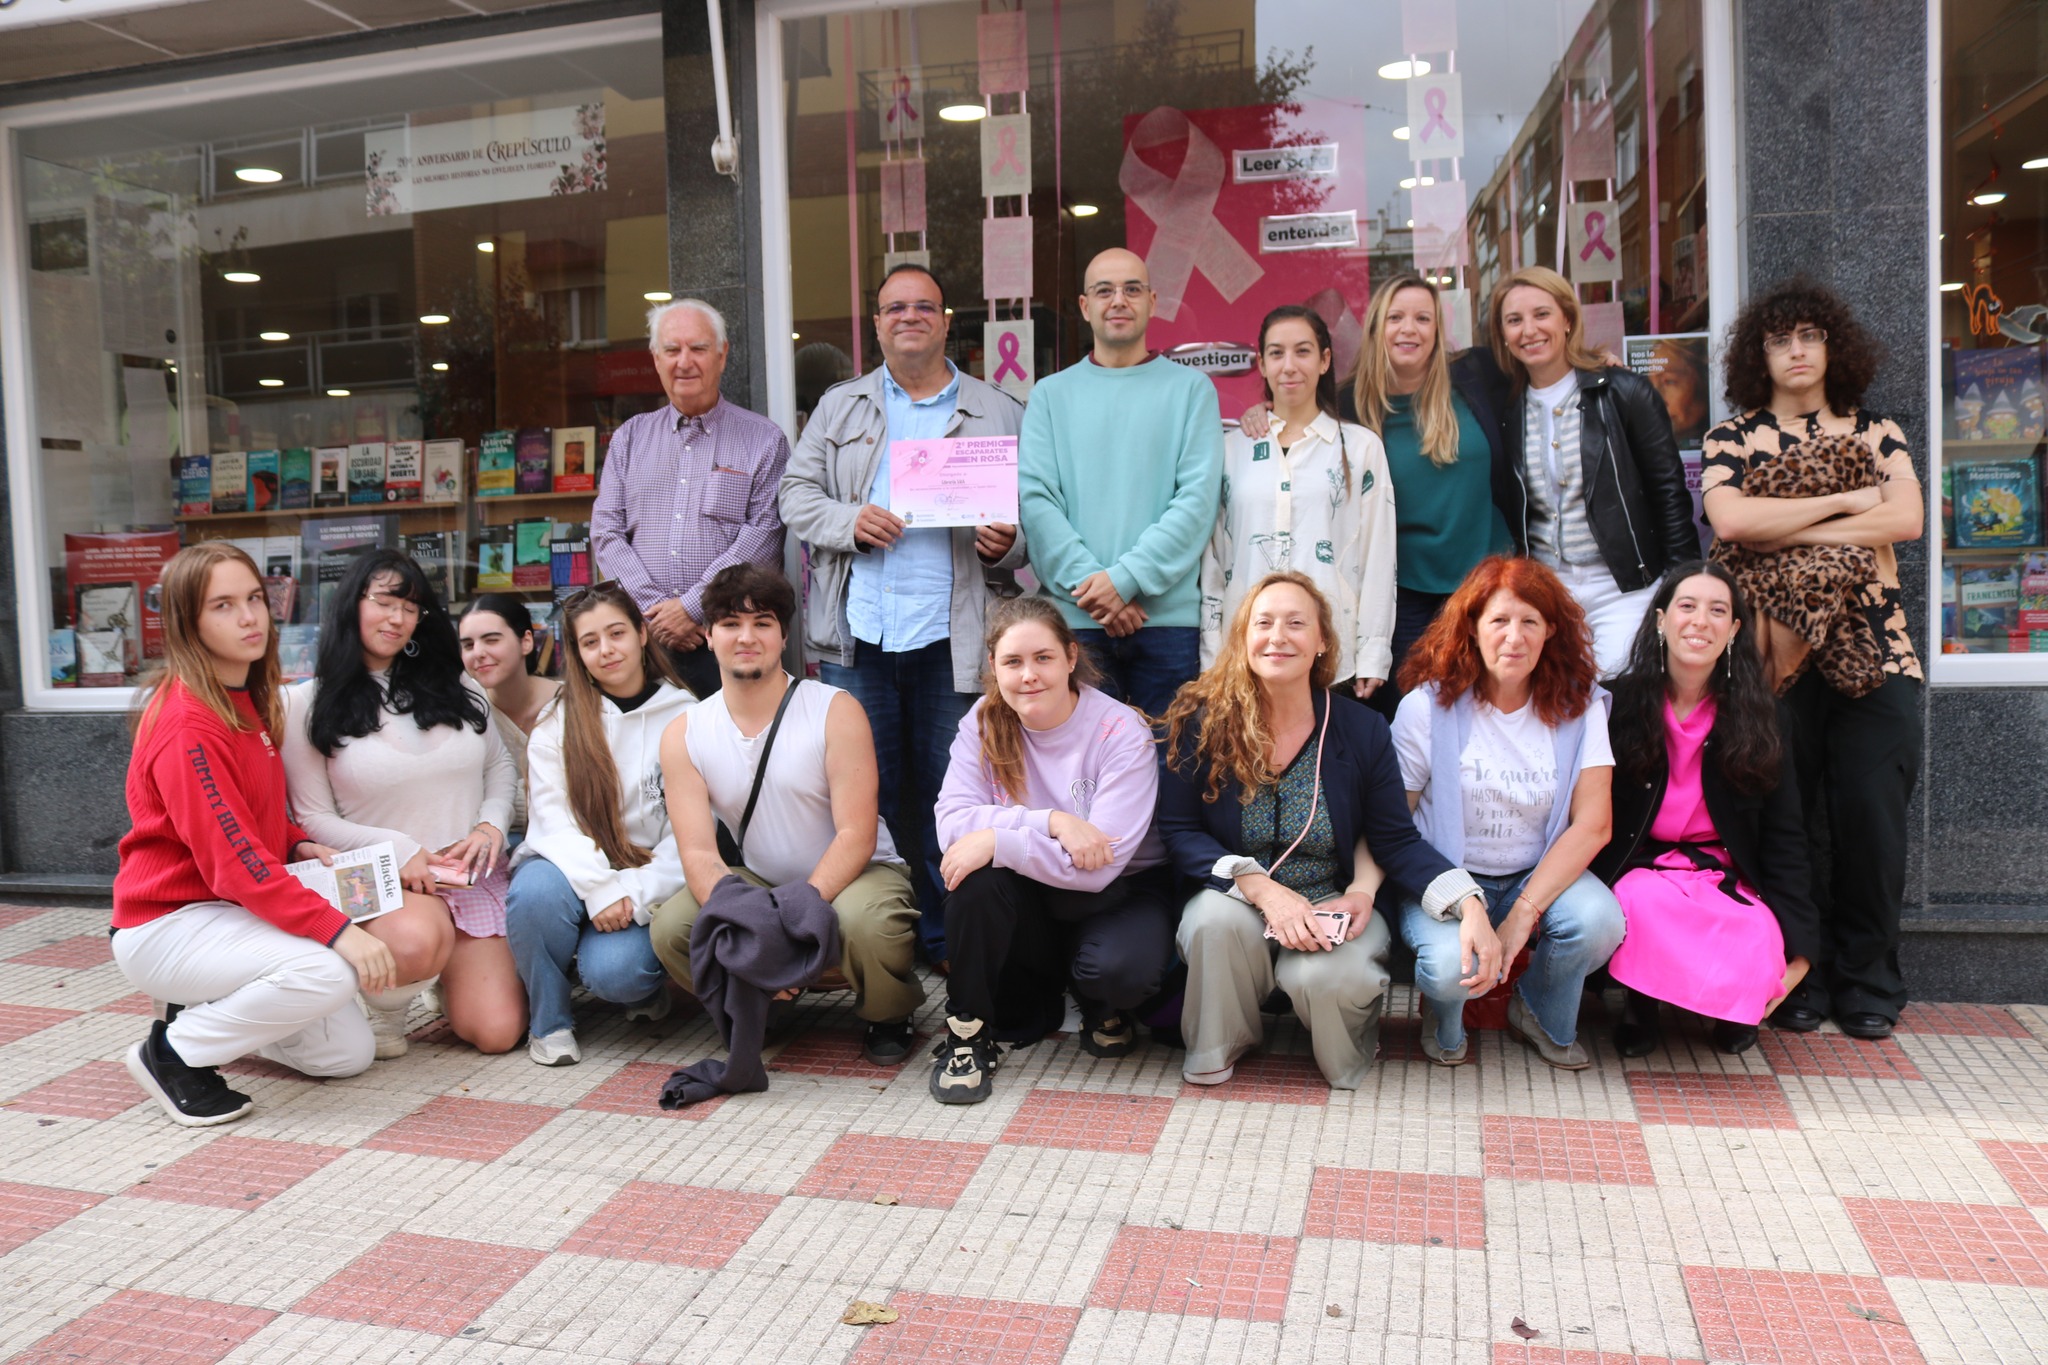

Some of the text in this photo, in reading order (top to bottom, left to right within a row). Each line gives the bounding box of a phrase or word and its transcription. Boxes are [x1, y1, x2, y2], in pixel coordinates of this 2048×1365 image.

[417, 150, 470, 166] ANIVERSARIO
[472, 148, 484, 159] DE
[1242, 157, 1281, 173] Leer
[1267, 222, 1349, 242] entender
[1631, 357, 1669, 366] tomamos
[1646, 350, 1655, 358] lo
[955, 448, 1008, 456] ESCAPARATES
[967, 440, 1004, 449] PREMIO
[966, 454, 1009, 463] EN ROSA
[1969, 471, 2021, 481] Monstruos
[417, 541, 432, 550] KEN
[1473, 758, 1493, 782] Te
[1471, 787, 1503, 803] HASTA
[1509, 790, 1520, 804] EL
[187, 743, 272, 884] TOMMY HILFIGER
[1491, 806, 1523, 820] más
[1479, 823, 1515, 839] allá
[378, 853, 395, 899] Blackie
